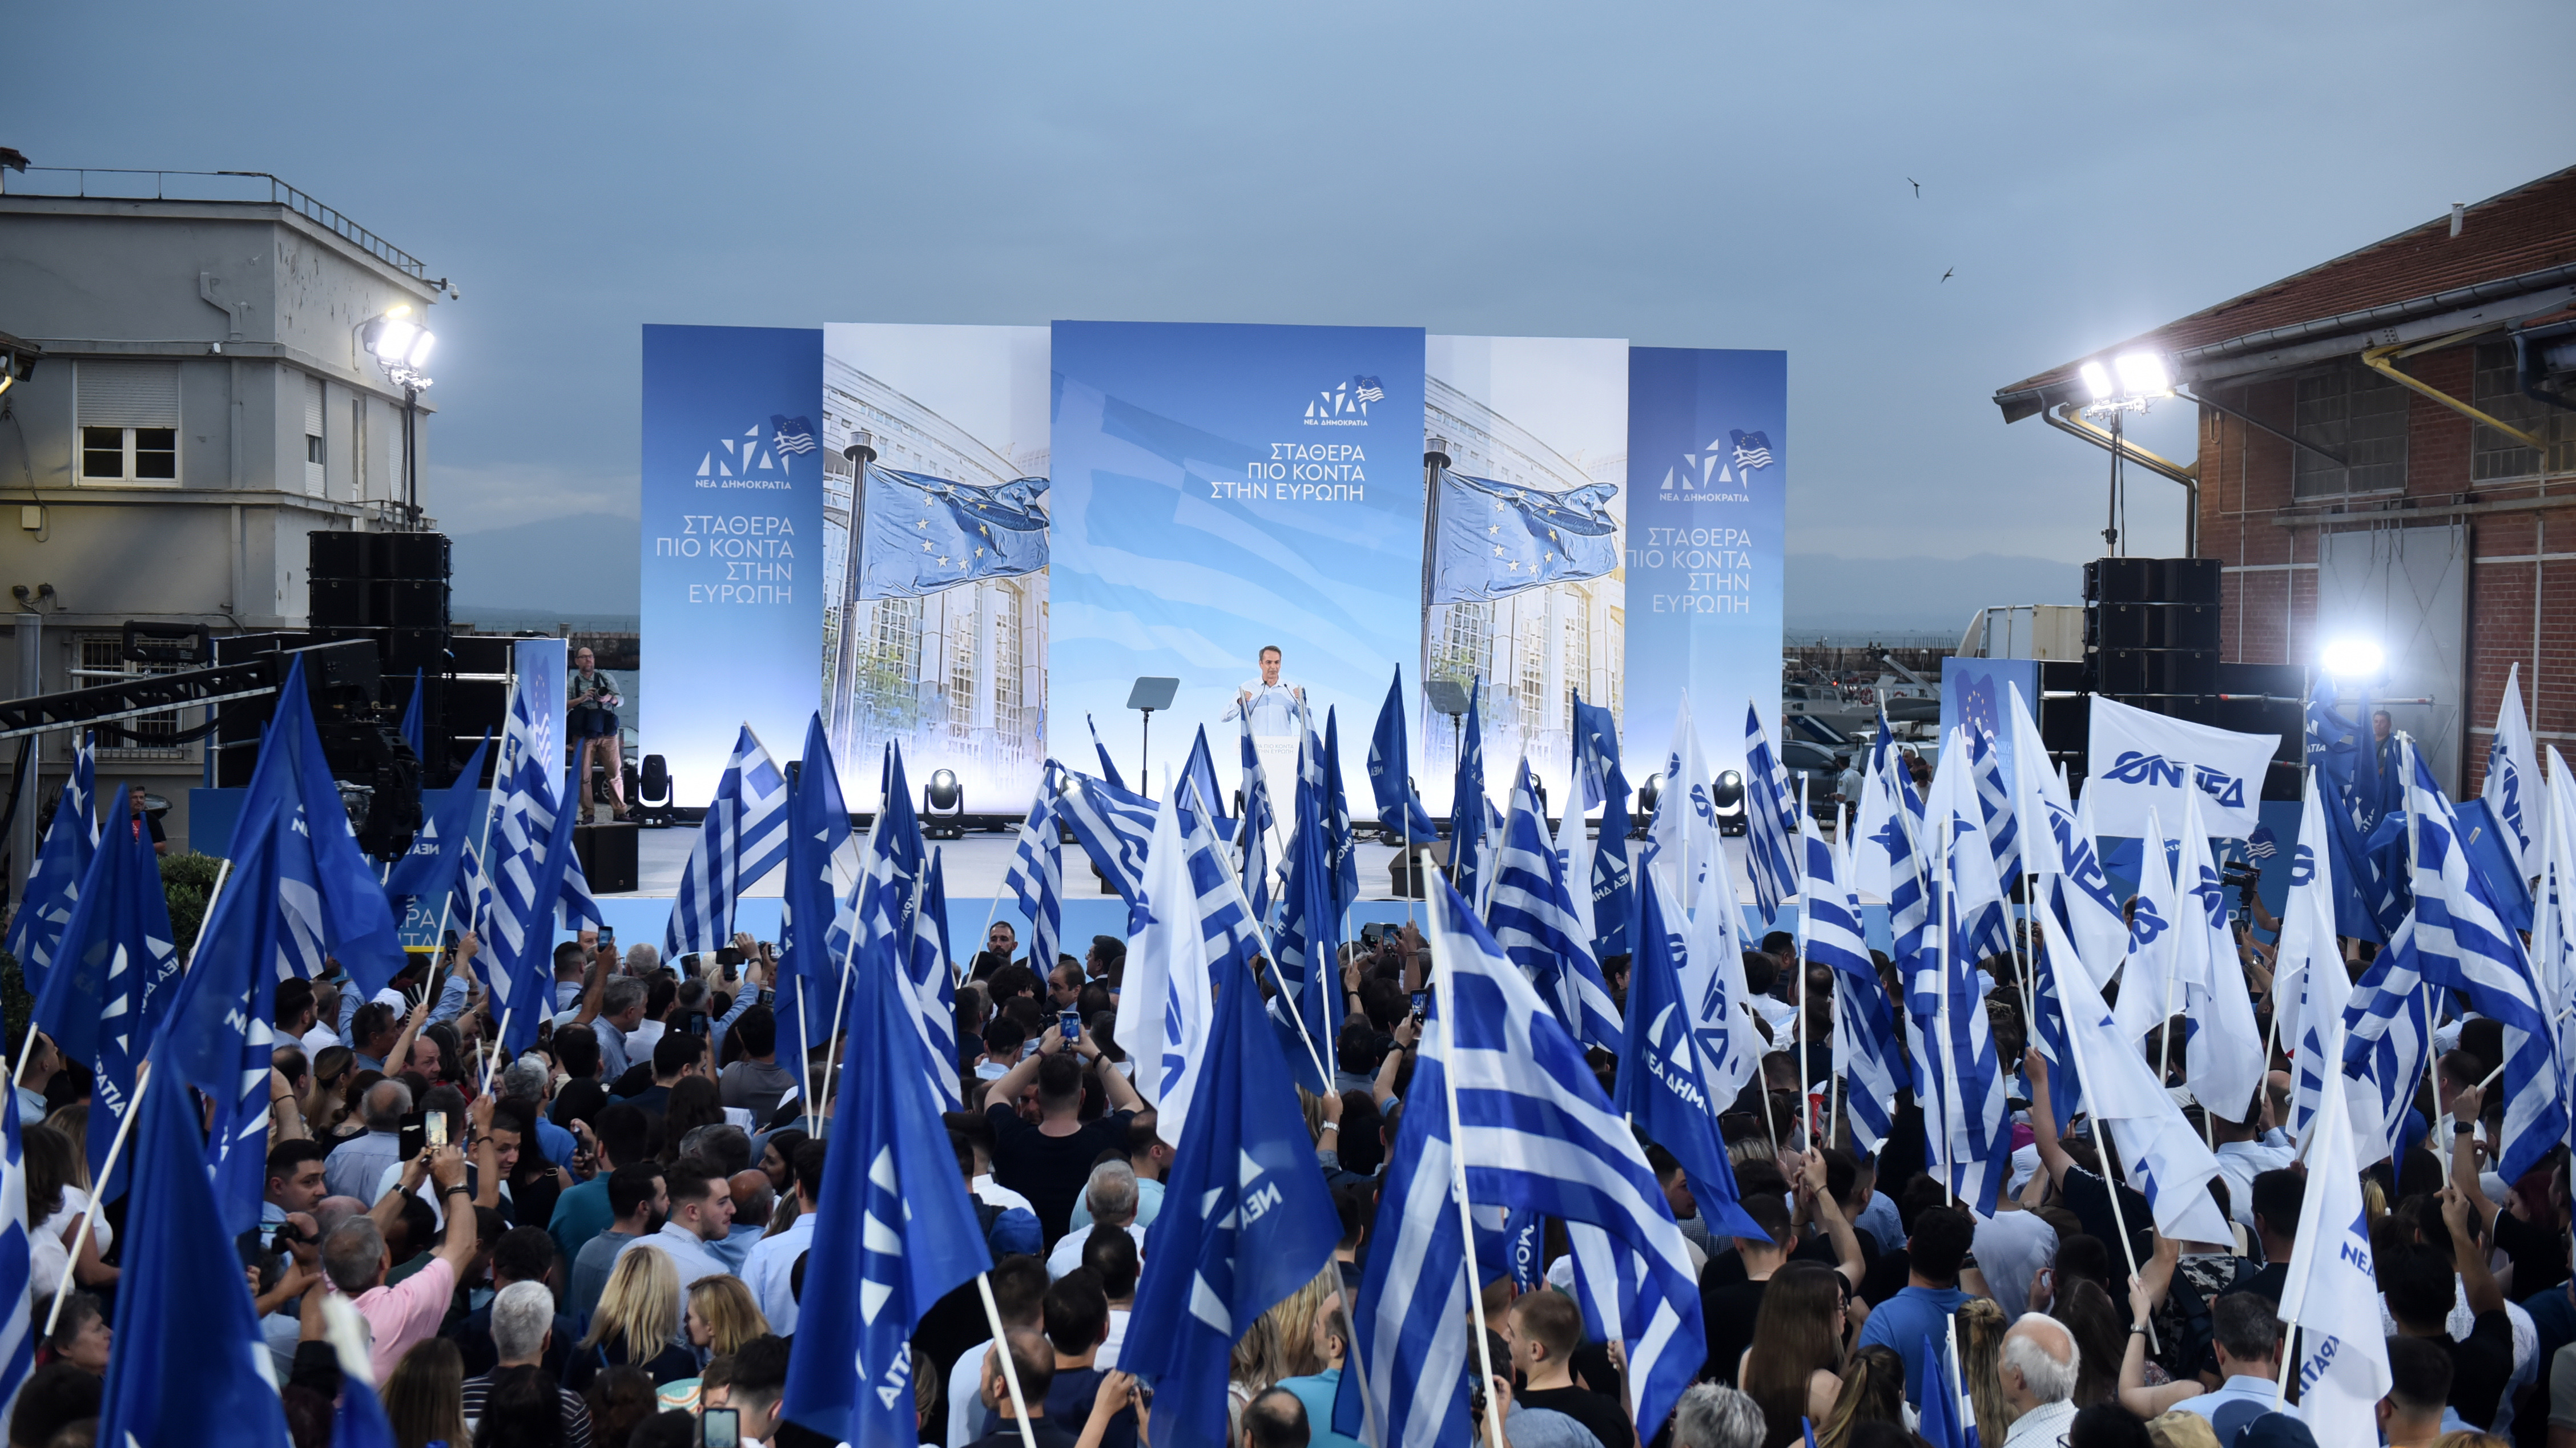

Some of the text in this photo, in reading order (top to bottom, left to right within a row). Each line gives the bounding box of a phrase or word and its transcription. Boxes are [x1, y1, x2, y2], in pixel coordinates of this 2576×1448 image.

[1270, 443, 1366, 461] ΣΤΑΘΕΡΑ
[1249, 462, 1366, 482] ΠΙΟ ΚΟΝΤΑ
[695, 479, 792, 490] ΝΕΑ ΔΗΜΟΚΡΑΤΙΑ
[1210, 482, 1365, 501] ΣΤΗΝ ΕΥΡΩΠΗ
[1660, 493, 1749, 503] ΝΕΑ ΔΗΜΟΚΡΑΤΙΑ
[683, 515, 795, 535] ΣΤΑΘΕΡΑ
[1648, 528, 1752, 547] ΣΤΑΘΕΡΑ
[657, 538, 795, 559] ΠΙΟ ΚΟΝΤΑ
[1672, 550, 1752, 570] ΚΟΝΤΑ
[726, 562, 792, 582] ΣΤΗΝ
[1688, 572, 1749, 591] ΣΤΗΝ
[689, 584, 792, 604] ΕΥΡΩΠΗ
[1653, 594, 1749, 613] ΕΥΡΩΠΗ
